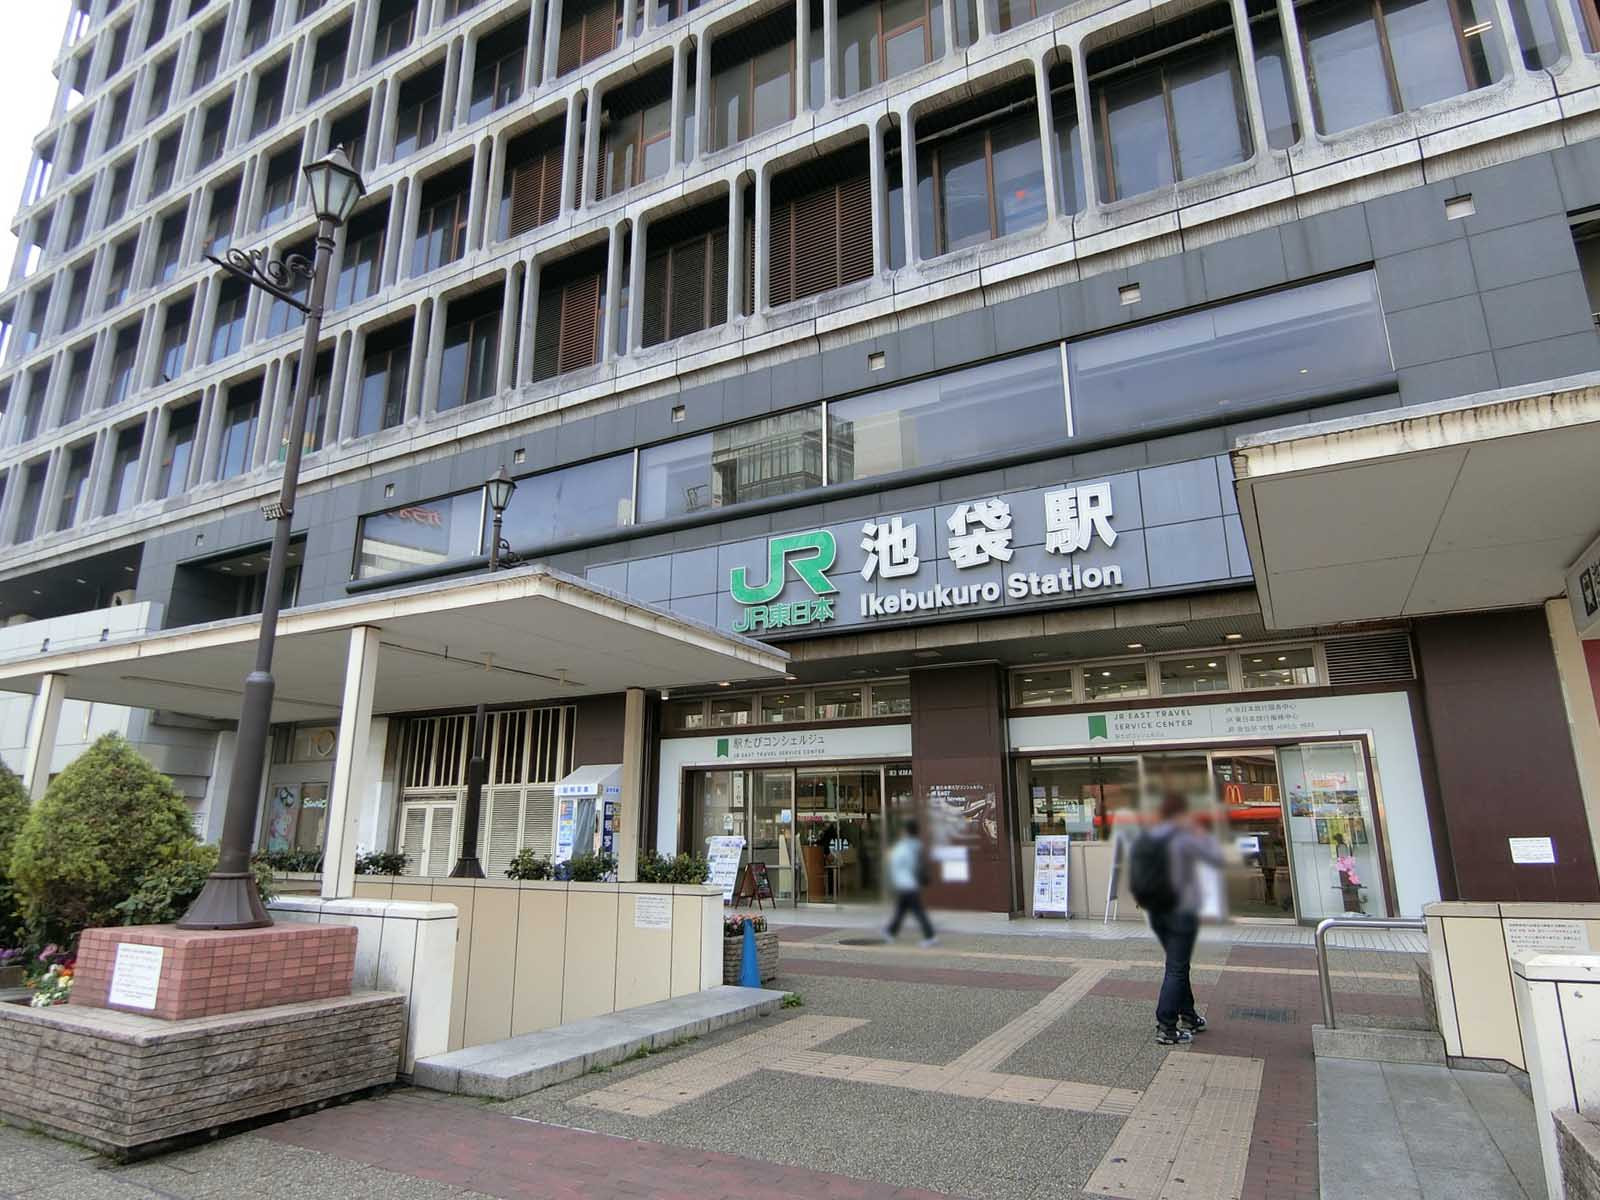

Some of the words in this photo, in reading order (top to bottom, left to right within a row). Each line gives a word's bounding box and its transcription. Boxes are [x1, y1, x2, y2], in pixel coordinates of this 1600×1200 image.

[860, 482, 1118, 582] 池袋駅
[730, 530, 838, 604] JR
[860, 581, 1000, 617] Ikebukuro
[1007, 564, 1123, 598] Station
[731, 597, 836, 632] JR東日本
[1114, 721, 1153, 731] SERVICE
[1156, 719, 1193, 728] CENTER
[1128, 711, 1150, 719] EAST
[1156, 709, 1192, 718] TRAVEL
